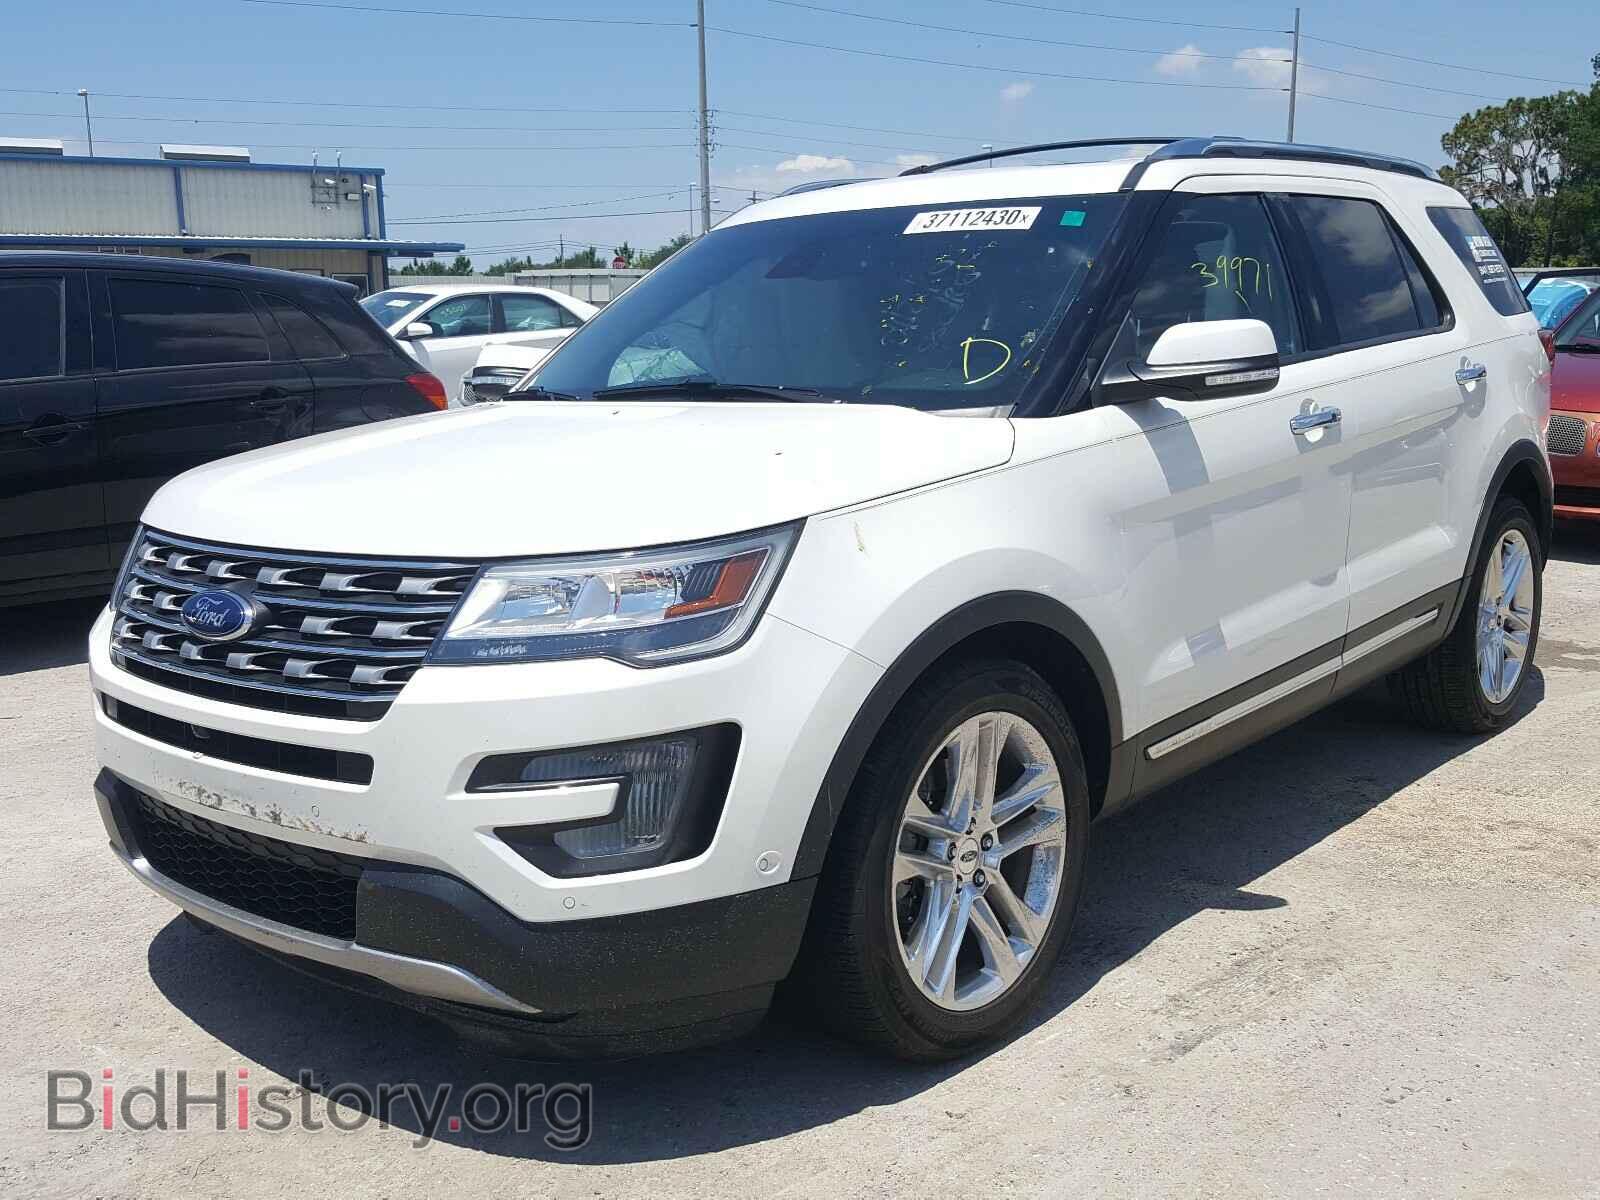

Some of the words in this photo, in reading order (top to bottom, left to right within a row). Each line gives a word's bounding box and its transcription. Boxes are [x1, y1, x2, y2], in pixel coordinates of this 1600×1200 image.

[1191, 255, 1273, 303] 39971
[960, 336, 1012, 385] D
[186, 597, 230, 627] Ford
